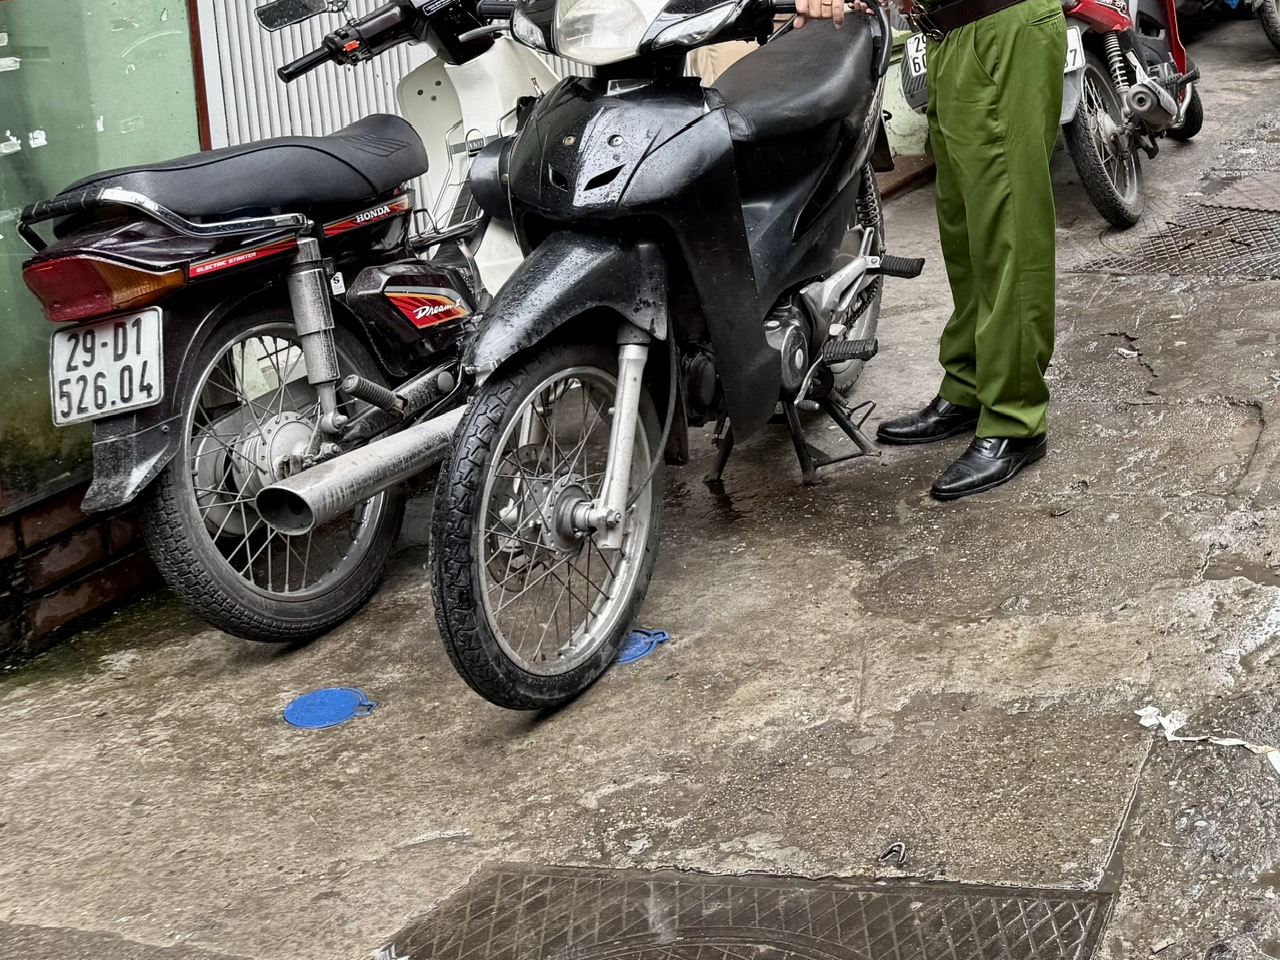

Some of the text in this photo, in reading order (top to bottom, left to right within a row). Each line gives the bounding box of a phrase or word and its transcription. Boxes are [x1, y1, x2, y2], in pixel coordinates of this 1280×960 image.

[356, 205, 391, 223] HONDA
[196, 252, 257, 273] ELECTRIC STARTER
[413, 304, 454, 320] Dream
[66, 317, 143, 373] 29-D1
[58, 360, 154, 419] 526.04
